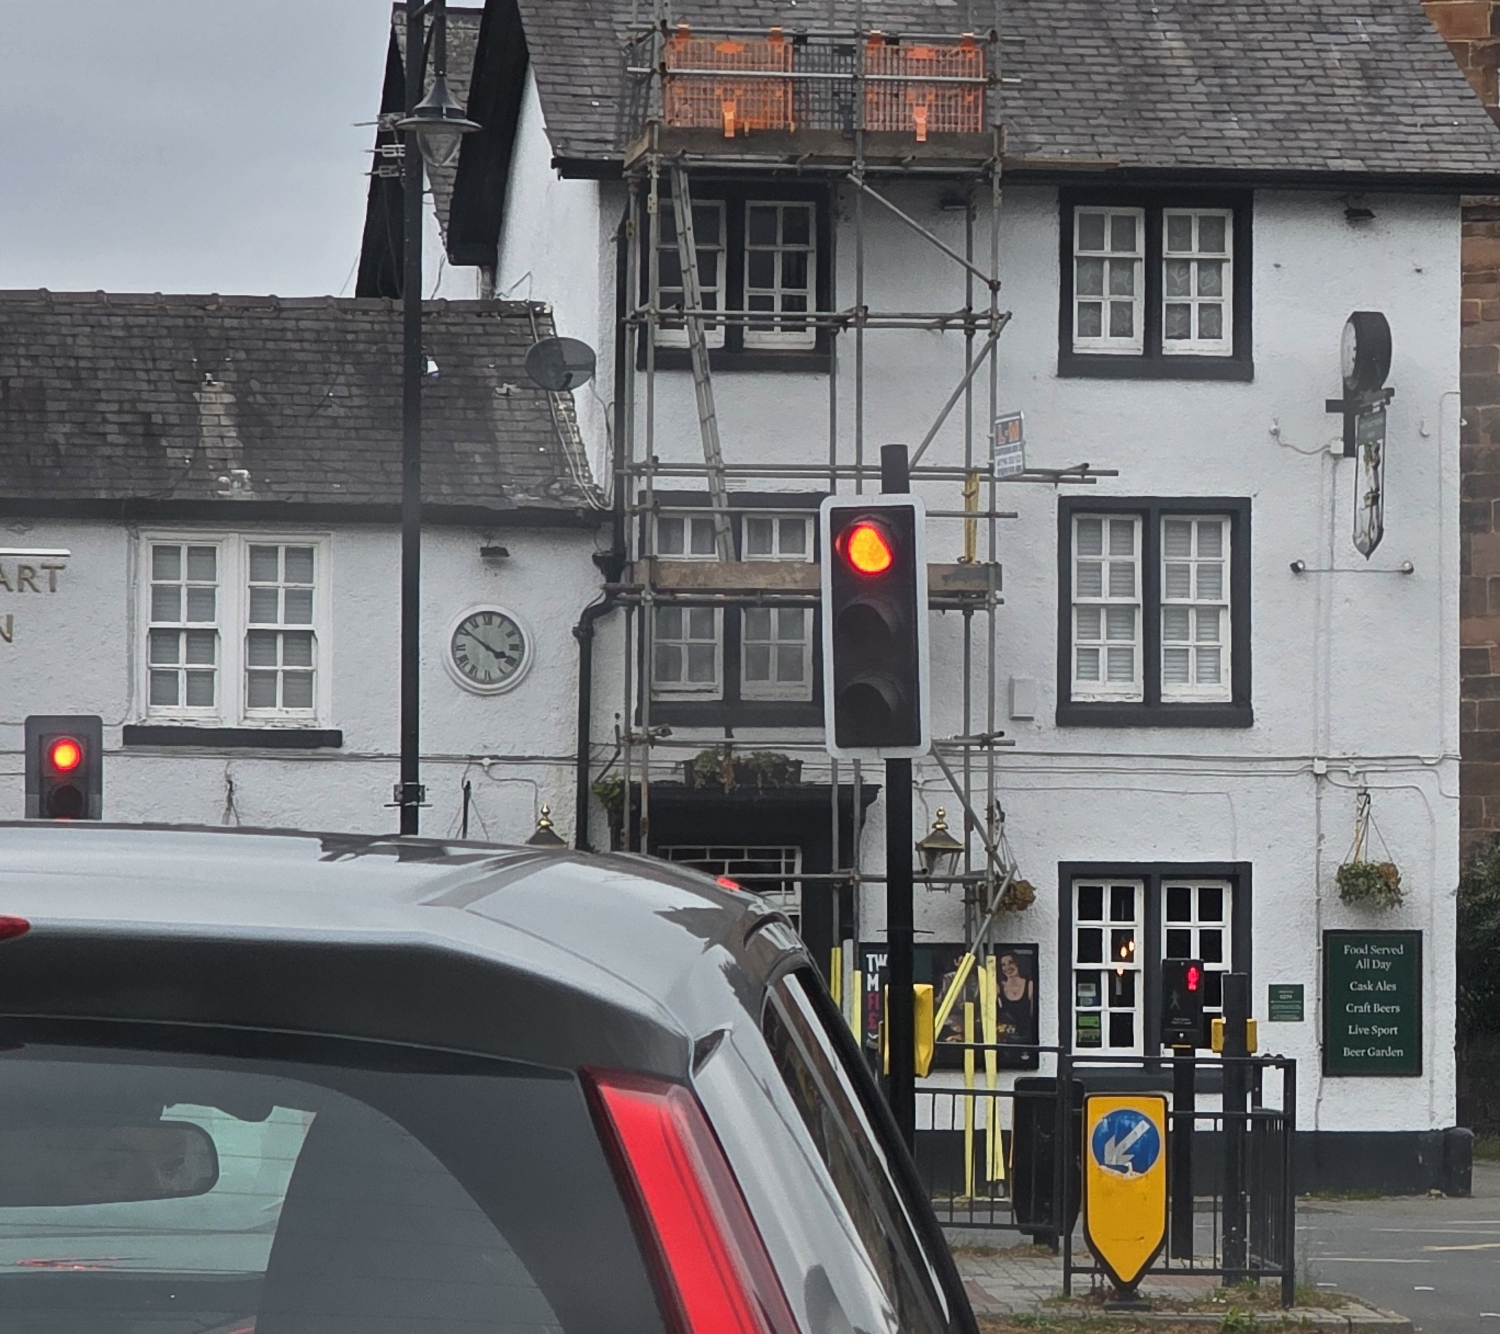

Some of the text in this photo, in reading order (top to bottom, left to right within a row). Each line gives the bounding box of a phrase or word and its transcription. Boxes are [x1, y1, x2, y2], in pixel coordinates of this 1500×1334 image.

[1343, 944, 1404, 955] Food Served
[866, 954, 888, 972] TW
[1355, 958, 1392, 971] All Day
[1349, 980, 1397, 991] Cask Ales
[1345, 1002, 1400, 1013] Craft Beers
[1348, 1024, 1398, 1037] Live Sport
[1343, 1046, 1404, 1057] Beer Garden
